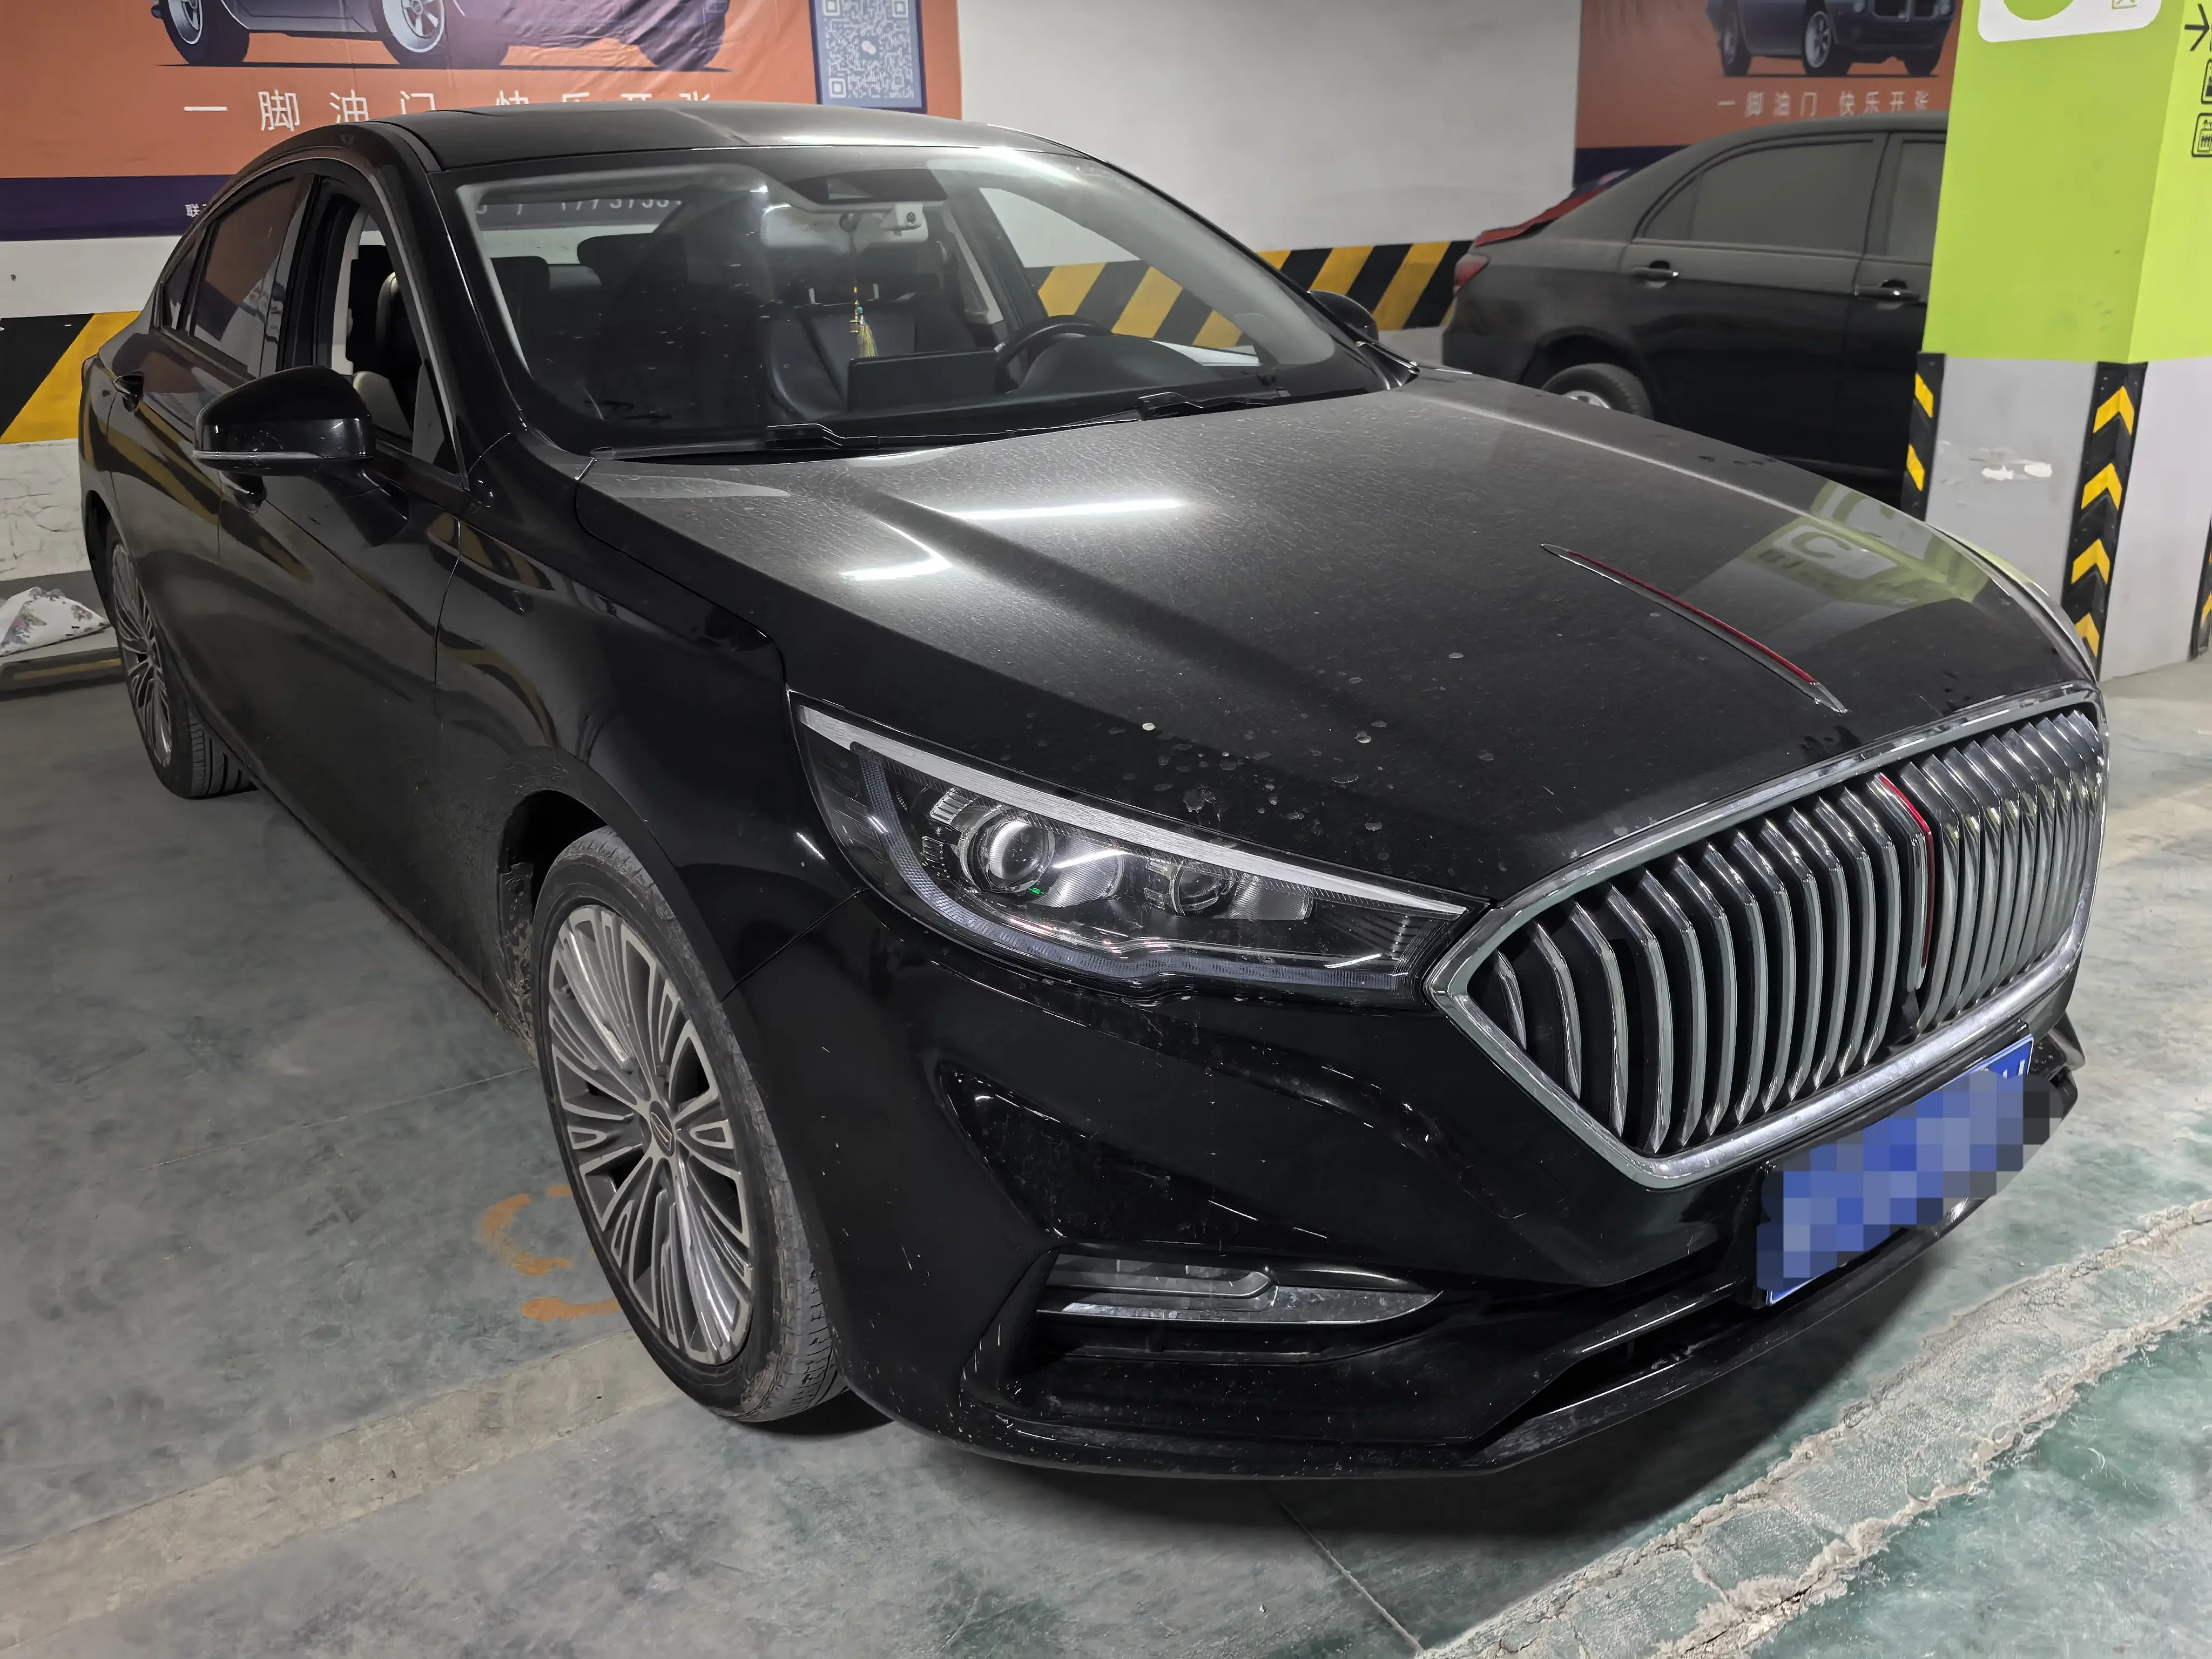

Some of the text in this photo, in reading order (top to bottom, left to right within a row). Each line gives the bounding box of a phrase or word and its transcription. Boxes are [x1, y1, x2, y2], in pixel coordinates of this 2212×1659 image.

[1718, 90, 1930, 117] 一脚油门 快乐开张
